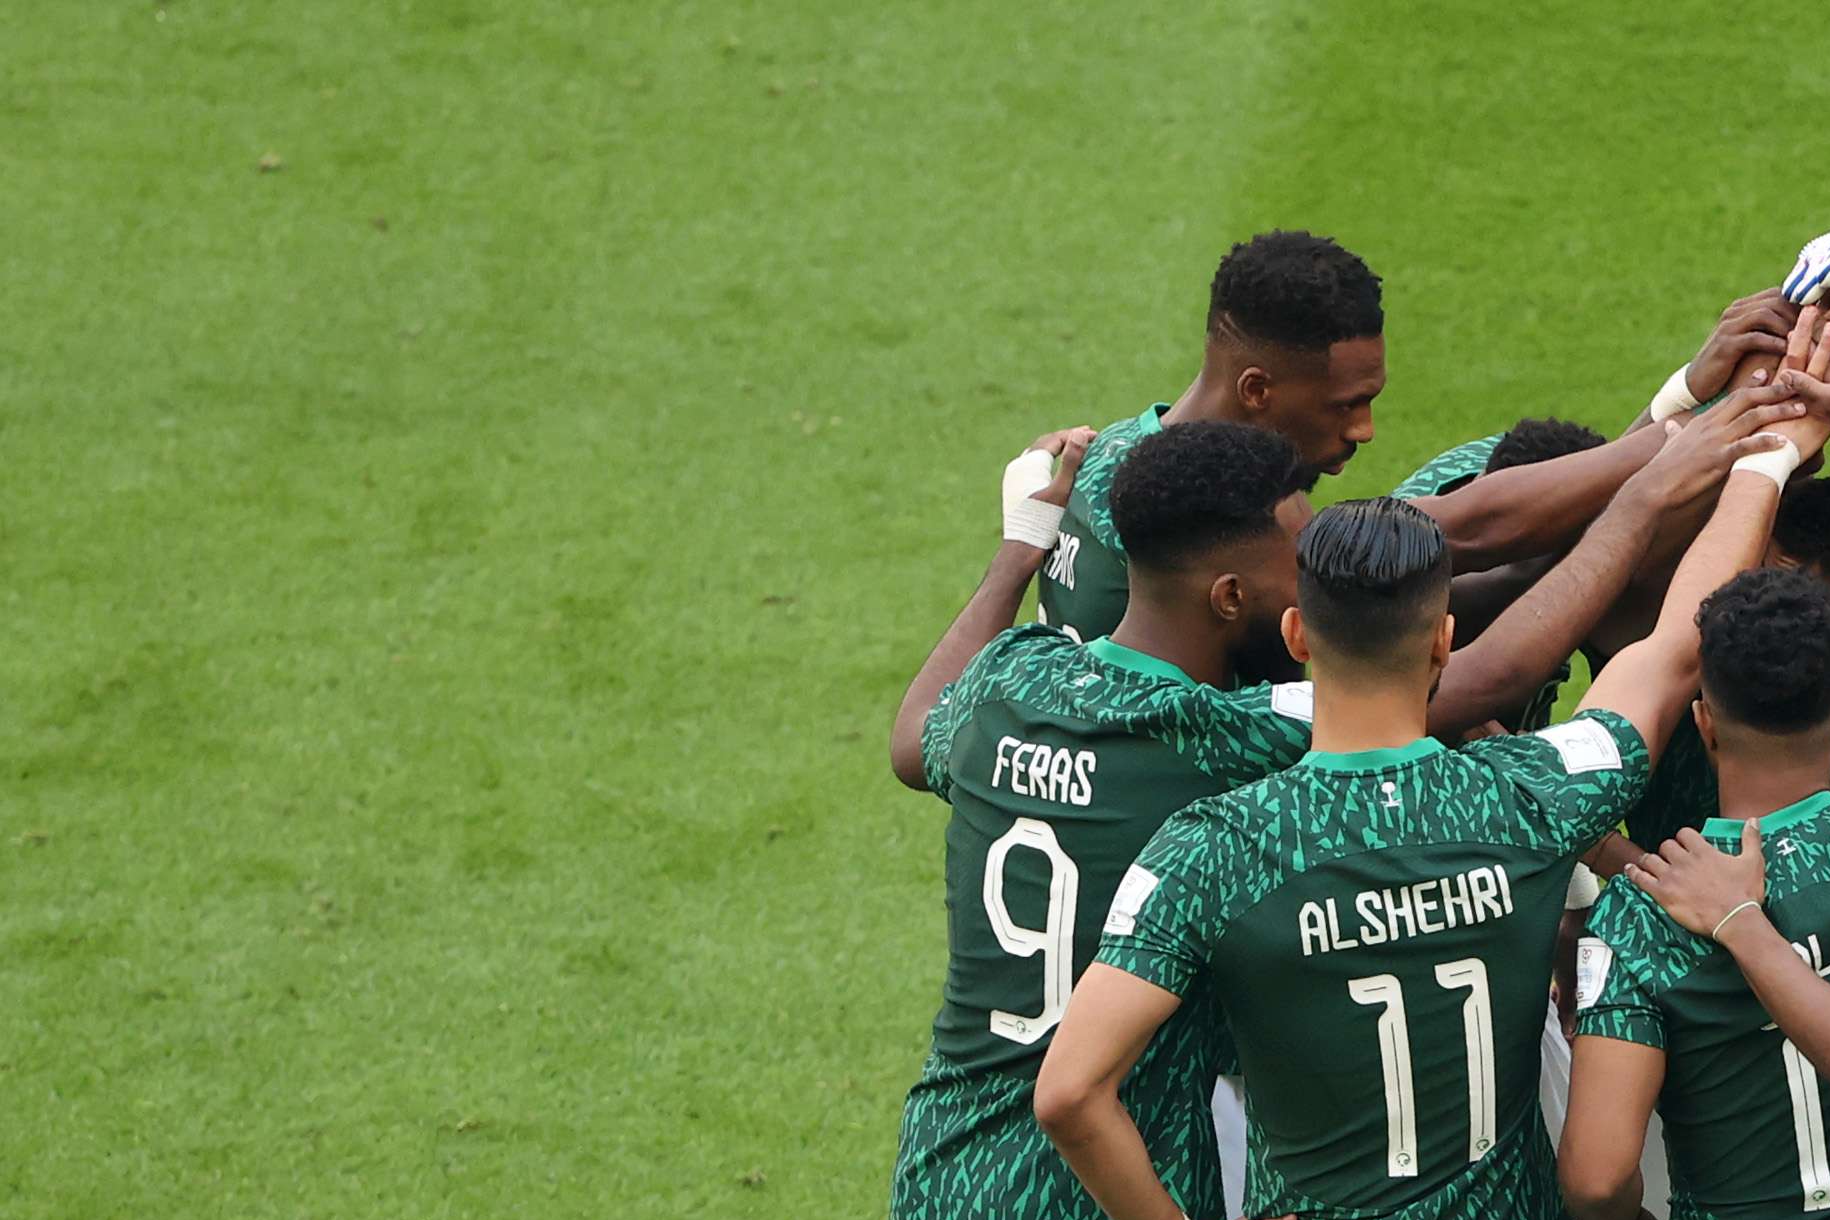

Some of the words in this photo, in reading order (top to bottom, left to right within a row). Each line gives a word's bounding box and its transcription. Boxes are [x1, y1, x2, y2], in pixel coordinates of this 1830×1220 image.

[991, 735, 1097, 806] FERAS
[983, 817, 1079, 1045] 9
[1347, 957, 1497, 1177] 11
